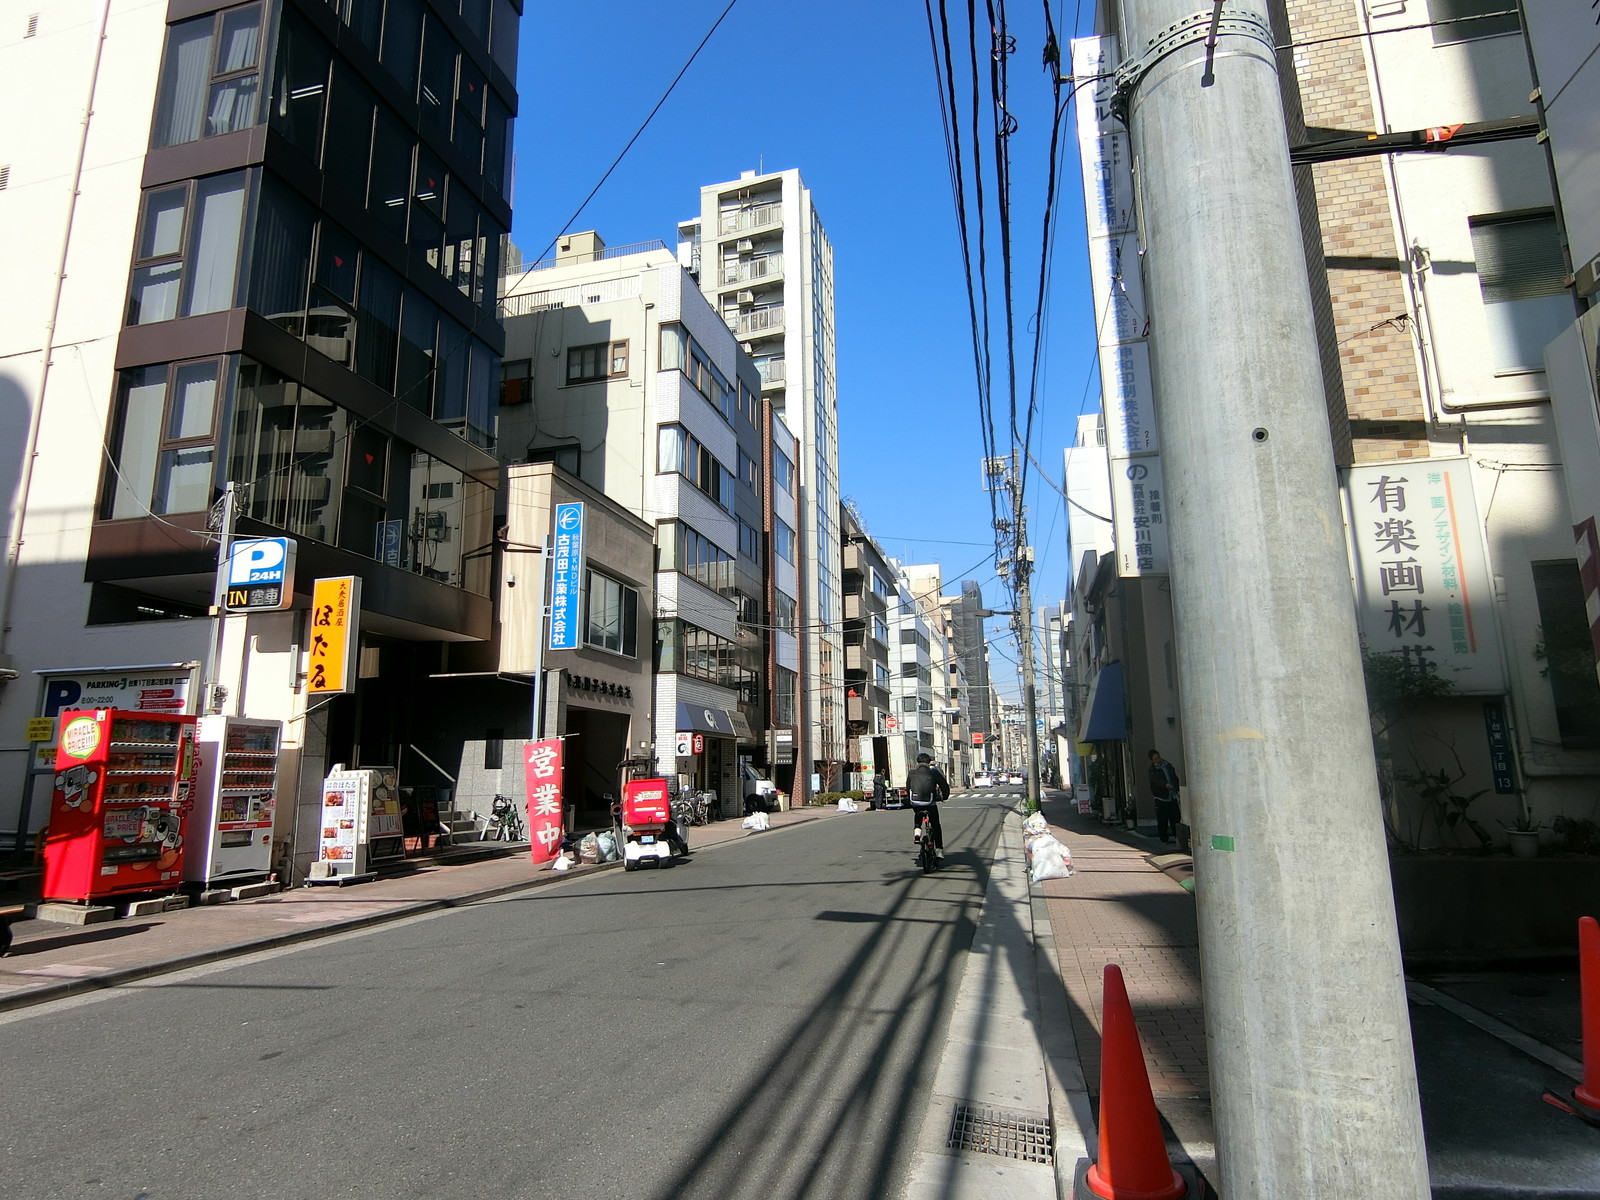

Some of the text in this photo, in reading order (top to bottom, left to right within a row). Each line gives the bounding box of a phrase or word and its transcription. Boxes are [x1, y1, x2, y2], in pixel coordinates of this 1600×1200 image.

[1149, 490, 1163, 525] 接着剤
[230, 541, 285, 584] P
[250, 570, 281, 581] 24H
[569, 533, 580, 595] 秋葉原KMDビル
[228, 588, 279, 606] IN 空車
[335, 581, 347, 626] 大衆居酒屋
[552, 533, 571, 646] 古茂田工業株式会社
[311, 605, 334, 688] ほたる
[66, 722, 96, 740] MIRACLE
[528, 747, 562, 853] 営業中
[1498, 778, 1511, 788] 13
